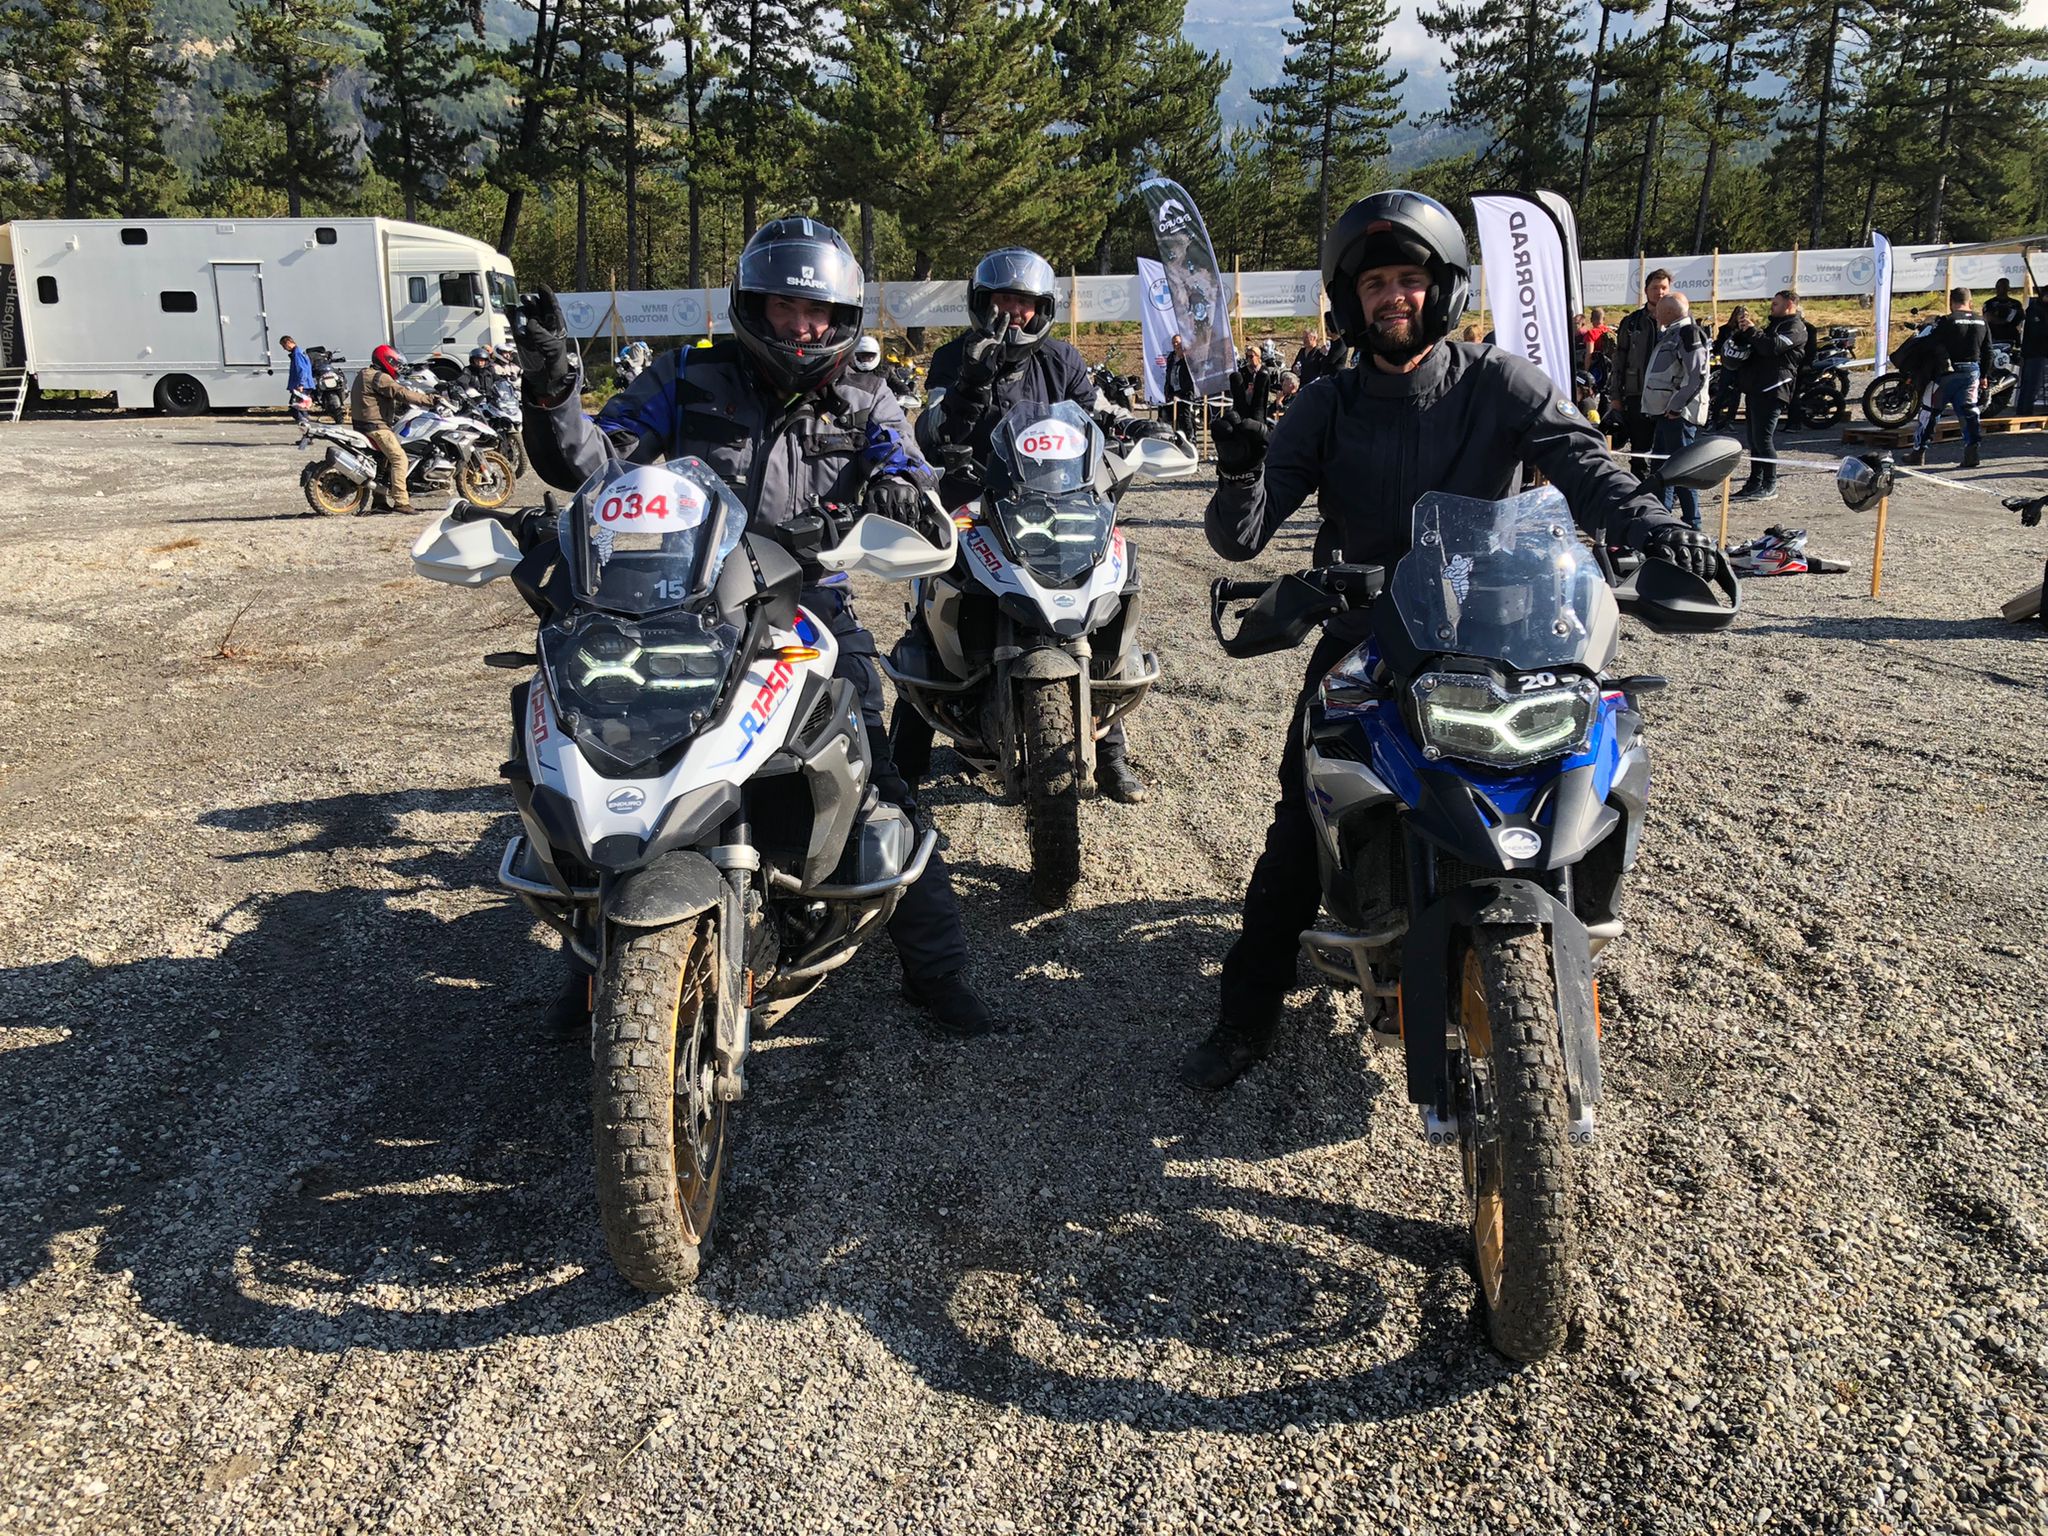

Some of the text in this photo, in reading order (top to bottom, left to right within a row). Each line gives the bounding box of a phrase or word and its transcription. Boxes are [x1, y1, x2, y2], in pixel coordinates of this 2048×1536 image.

[786, 277, 828, 289] SHARK
[1023, 434, 1065, 453] 057
[602, 493, 670, 522] 034
[654, 579, 686, 599] 15
